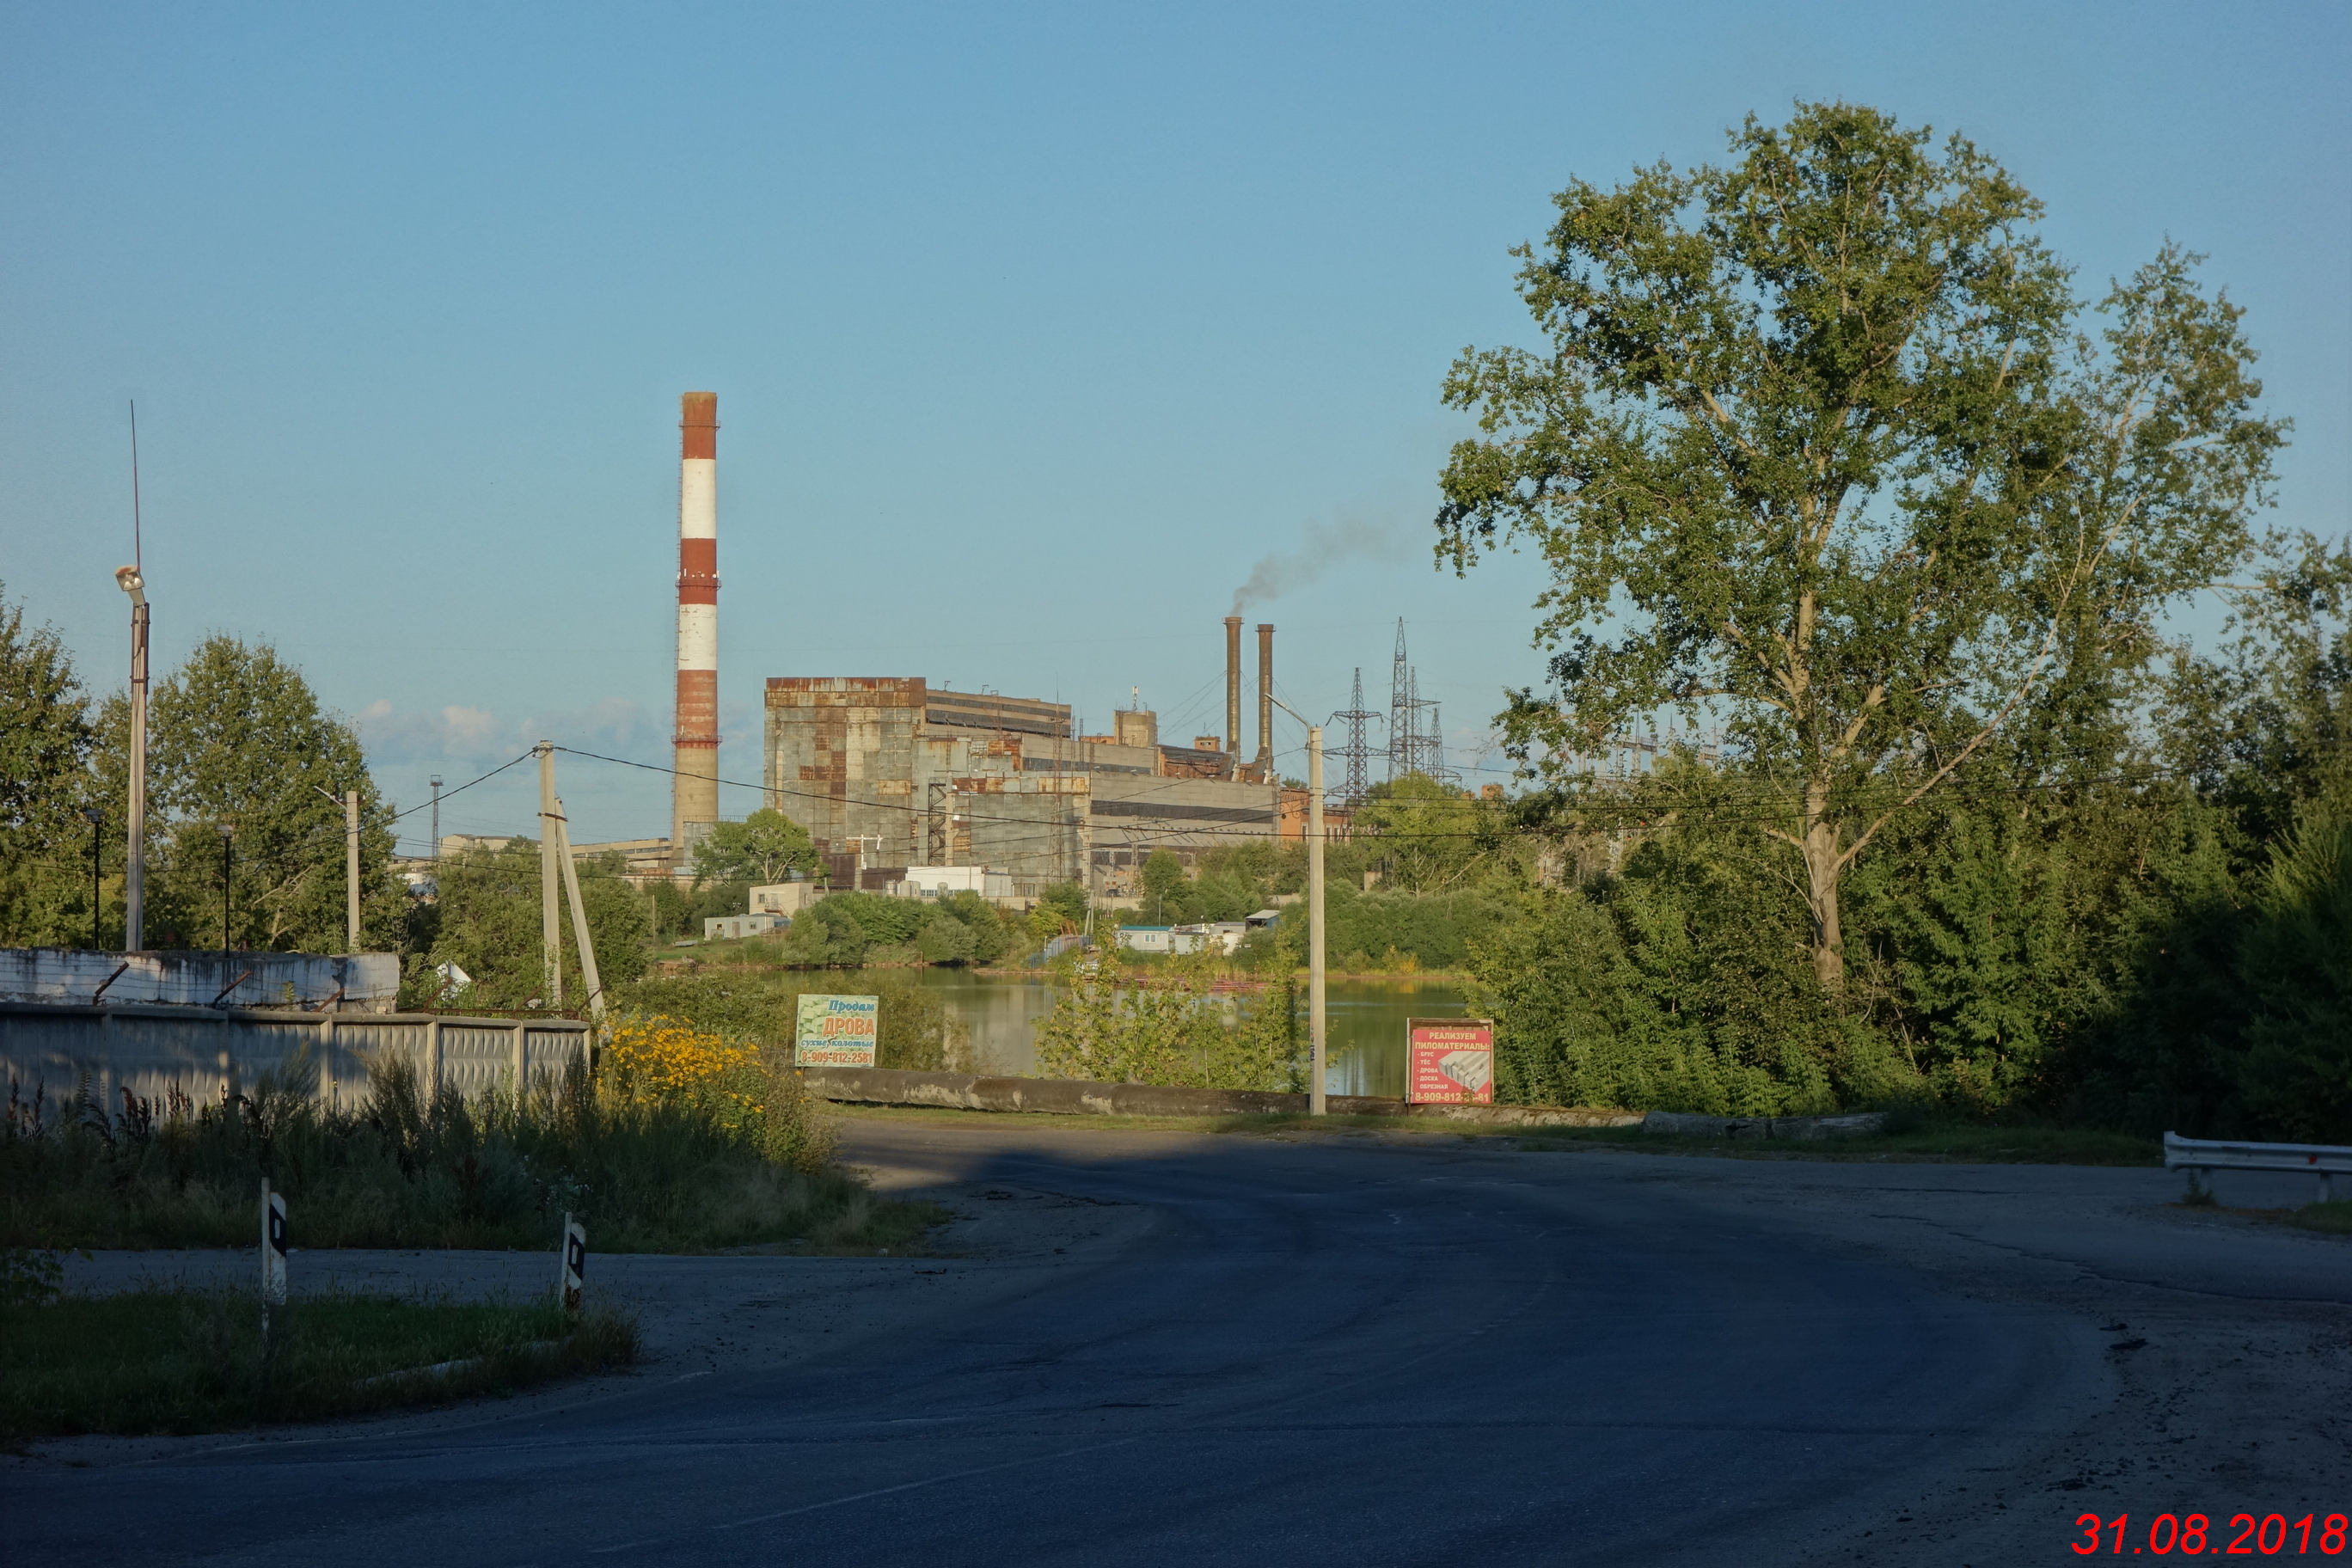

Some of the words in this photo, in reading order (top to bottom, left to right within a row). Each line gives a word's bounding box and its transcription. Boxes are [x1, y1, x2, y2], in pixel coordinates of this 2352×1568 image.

[829, 1000, 874, 1014] Продам
[823, 1018, 874, 1037] ДРОВА
[1429, 1032, 1476, 1040] РЕАЛИЗУЕМ
[1415, 1042, 1491, 1050] ПИЛОМАТЕРИАЛЫ:
[801, 1051, 873, 1063] 8-909-812-2581
